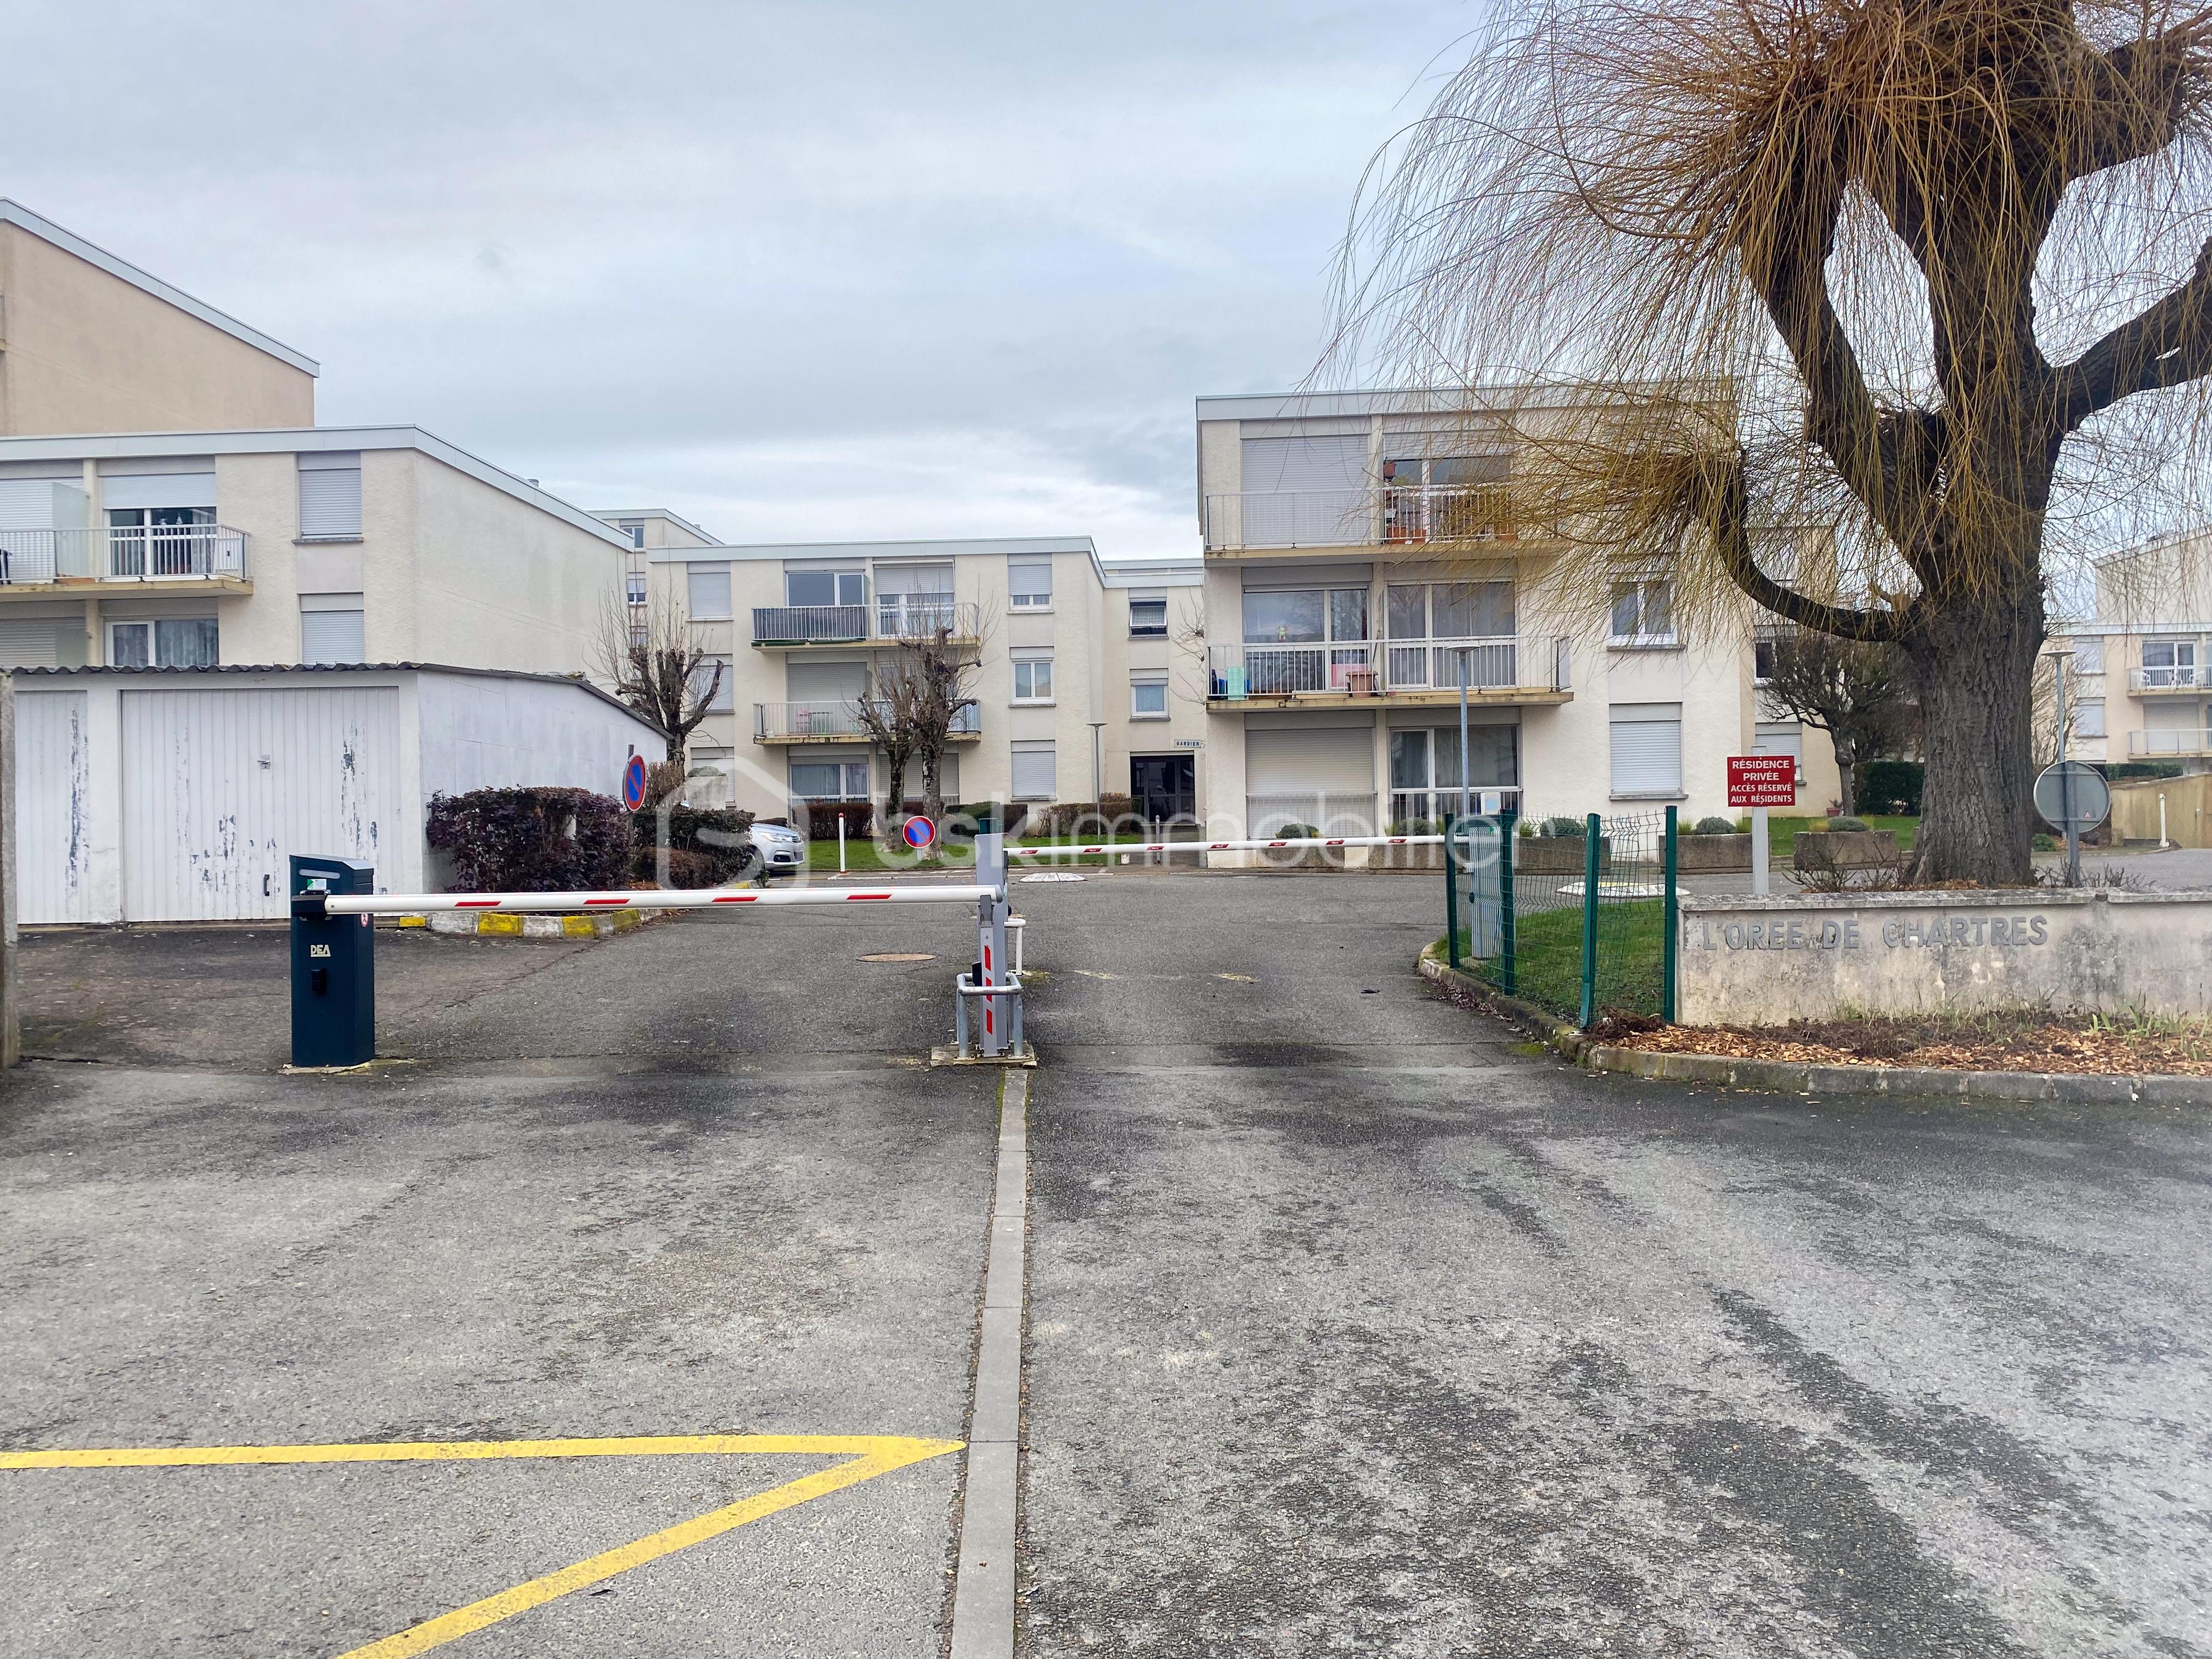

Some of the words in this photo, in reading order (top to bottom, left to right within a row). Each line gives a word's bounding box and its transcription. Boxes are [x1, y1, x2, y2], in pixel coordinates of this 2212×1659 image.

[1733, 759, 1790, 769] RÉSIDENCE
[1742, 770, 1780, 781] PRIVÉE
[1731, 783, 1756, 792] ACCÈS
[1758, 782, 1792, 792] RÉSERVÉ
[1751, 793, 1792, 803] RÉSIDENTS
[1702, 920, 1803, 950] L'OREE
[1822, 919, 1860, 949] DE
[1882, 915, 2048, 948] CHARTRES
[310, 944, 331, 957] DEA
